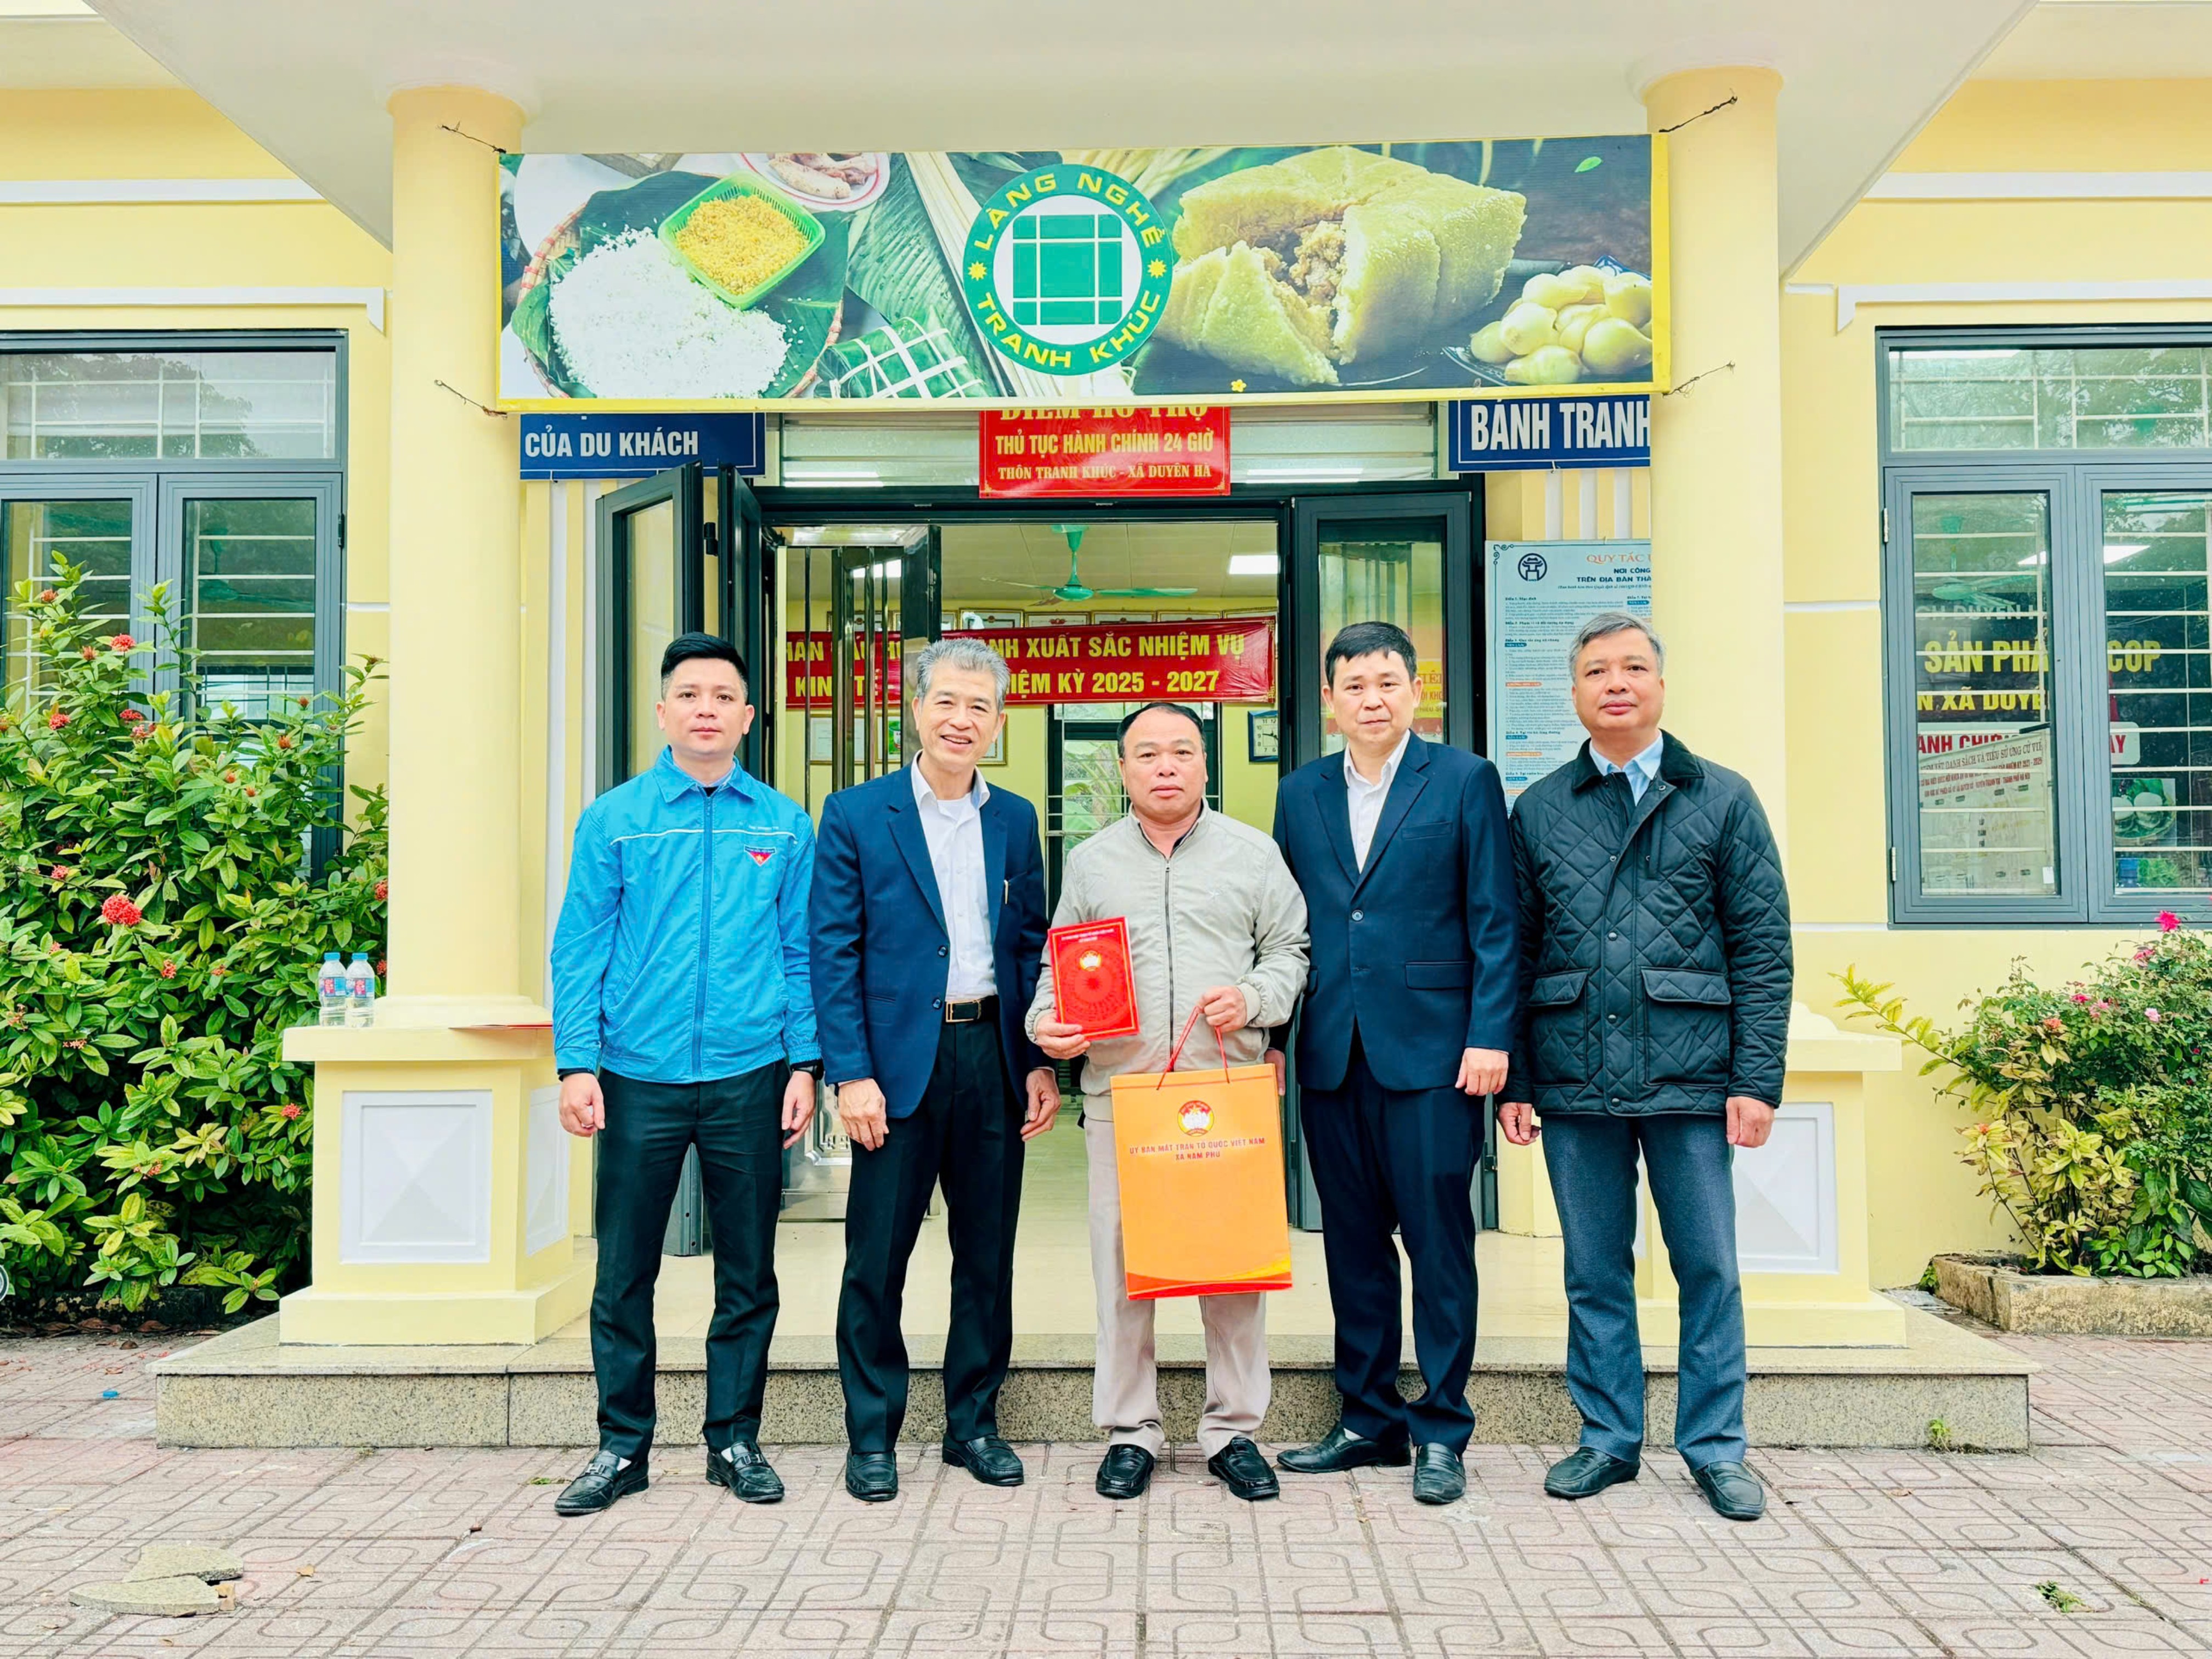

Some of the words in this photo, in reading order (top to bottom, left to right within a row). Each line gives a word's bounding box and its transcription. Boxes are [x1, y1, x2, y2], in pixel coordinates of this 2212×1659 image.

[974, 173, 1057, 251] LÀNG
[977, 292, 1071, 368] TRANH
[1089, 290, 1161, 363] KHÚC
[1471, 399, 1550, 450] BÁNH
[1559, 400, 1650, 449] TRANH
[525, 425, 572, 457] CỦA
[580, 432, 611, 456] DU
[619, 426, 698, 456] KHÁCH
[996, 428, 1024, 455] THỦ
[1029, 434, 1058, 458] TỤC
[1063, 430, 1106, 454] HÀNH
[1111, 429, 1159, 453] CHÍNH
[1164, 432, 1182, 453] 24
[1188, 427, 1214, 452] GIỜ
[998, 464, 1031, 479] THÔN
[1036, 466, 1077, 479] TRANH
[1082, 463, 1116, 478] KHÚC
[1127, 462, 1144, 478] XÃ
[1148, 462, 1190, 478] DUYÊN
[1194, 462, 1211, 477] HÀ
[1587, 554, 1616, 565] QUY
[1026, 633, 1081, 658] XUẤT
[1088, 631, 1132, 657] SẮC
[1139, 631, 1210, 660] NHIỆM
[1216, 634, 1245, 661] VỤ
[1925, 630, 1983, 673] SẢN
[2107, 640, 2160, 673] COP
[1058, 668, 1085, 693] KỲ
[1092, 672, 1145, 693] 2025
[1167, 670, 1220, 692] 2027
